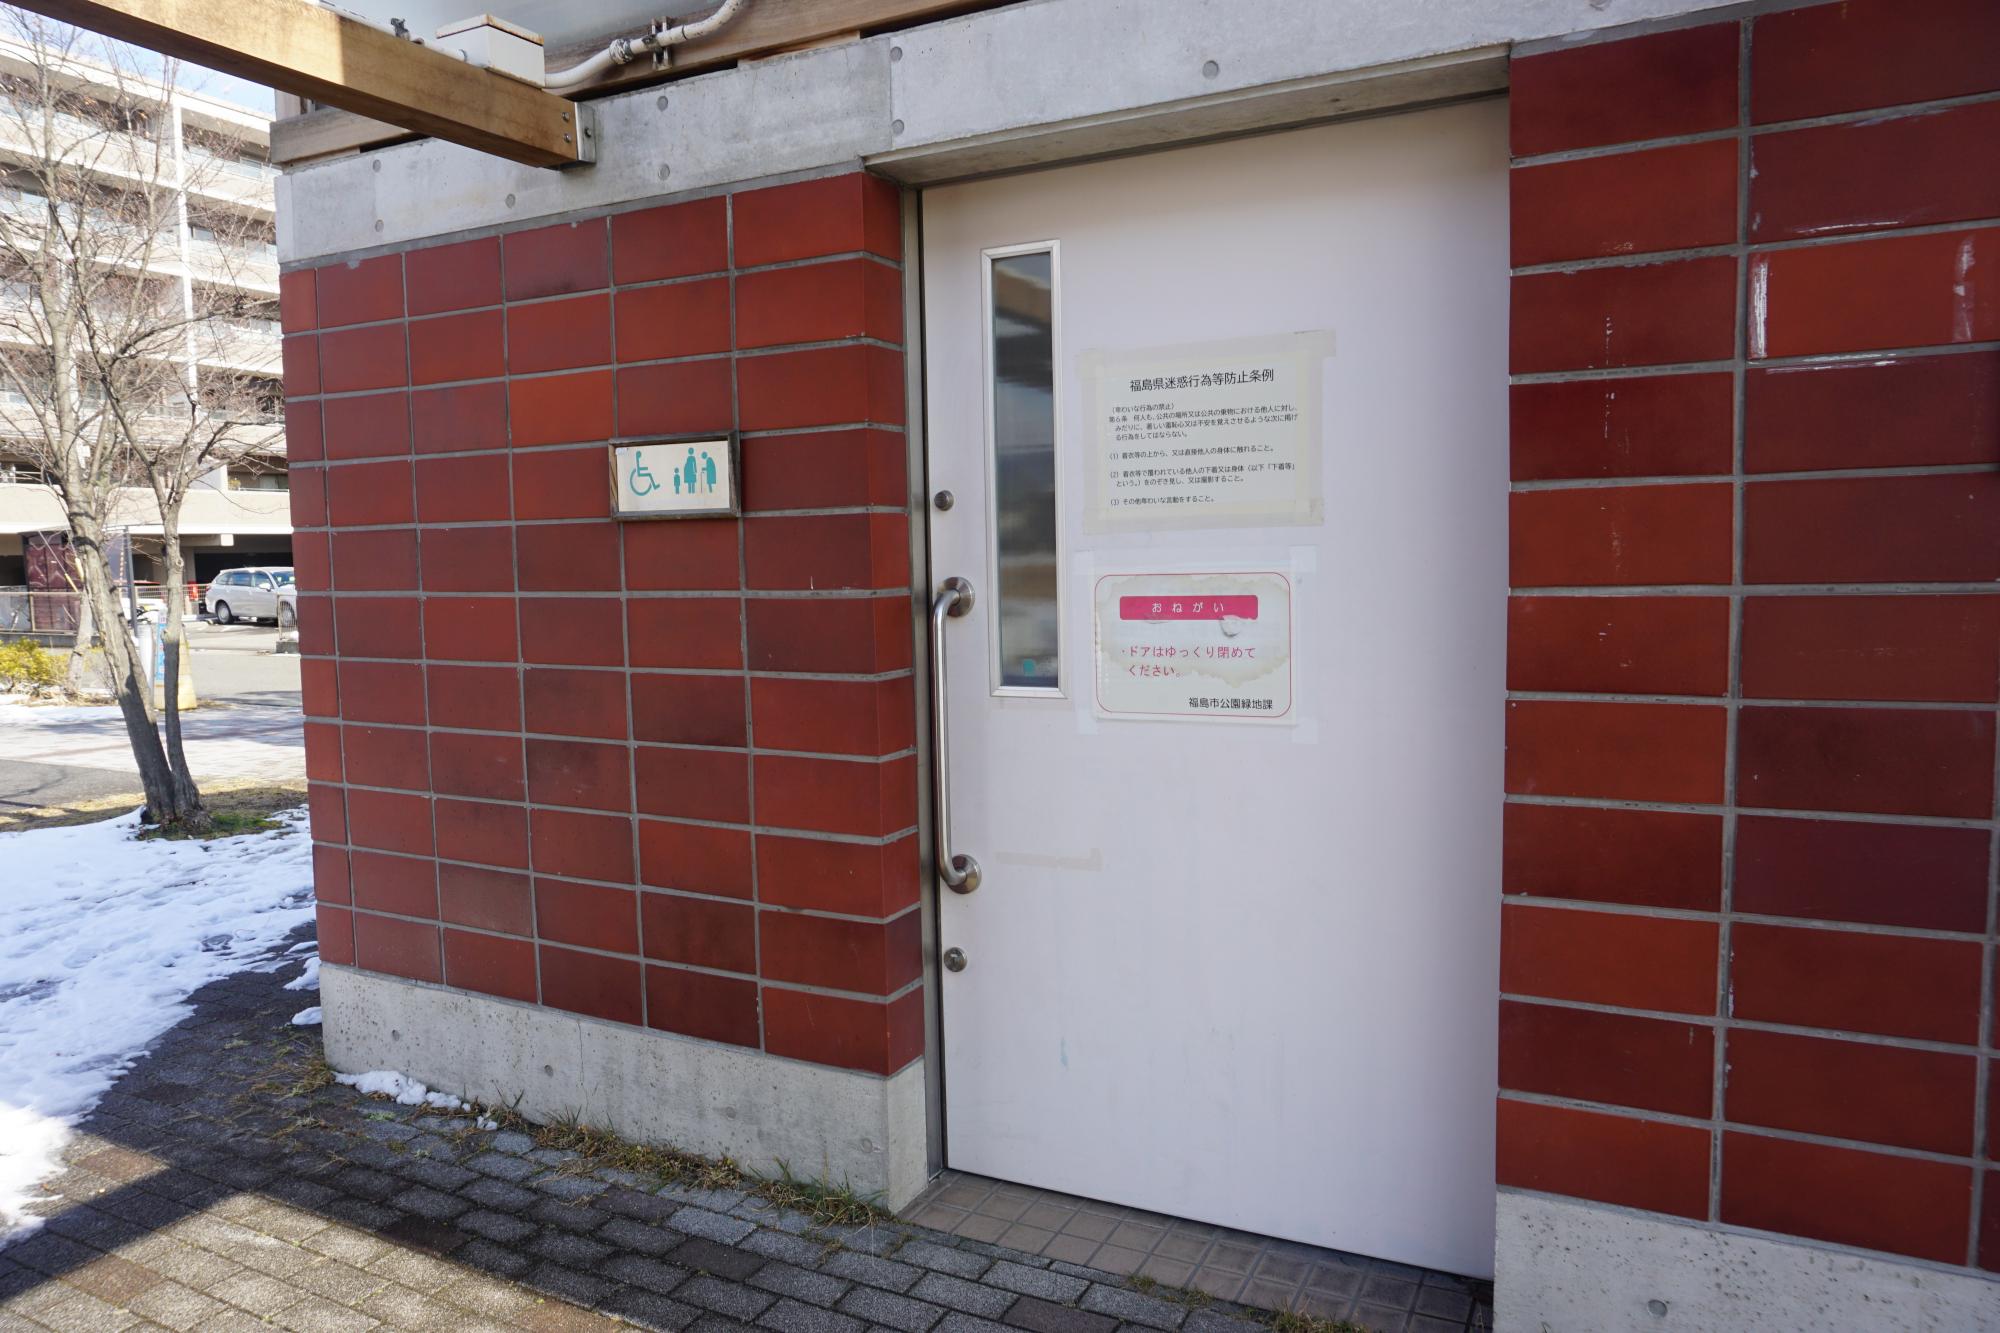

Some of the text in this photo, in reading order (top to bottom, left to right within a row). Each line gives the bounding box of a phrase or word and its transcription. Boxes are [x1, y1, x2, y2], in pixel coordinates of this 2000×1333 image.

[1130, 368, 1274, 393] 福島県迷惑行為等防止条例
[1151, 602, 1225, 613] おねがい
[1128, 664, 1184, 678] ください。
[1188, 696, 1273, 710] 福島市公園緑地課
